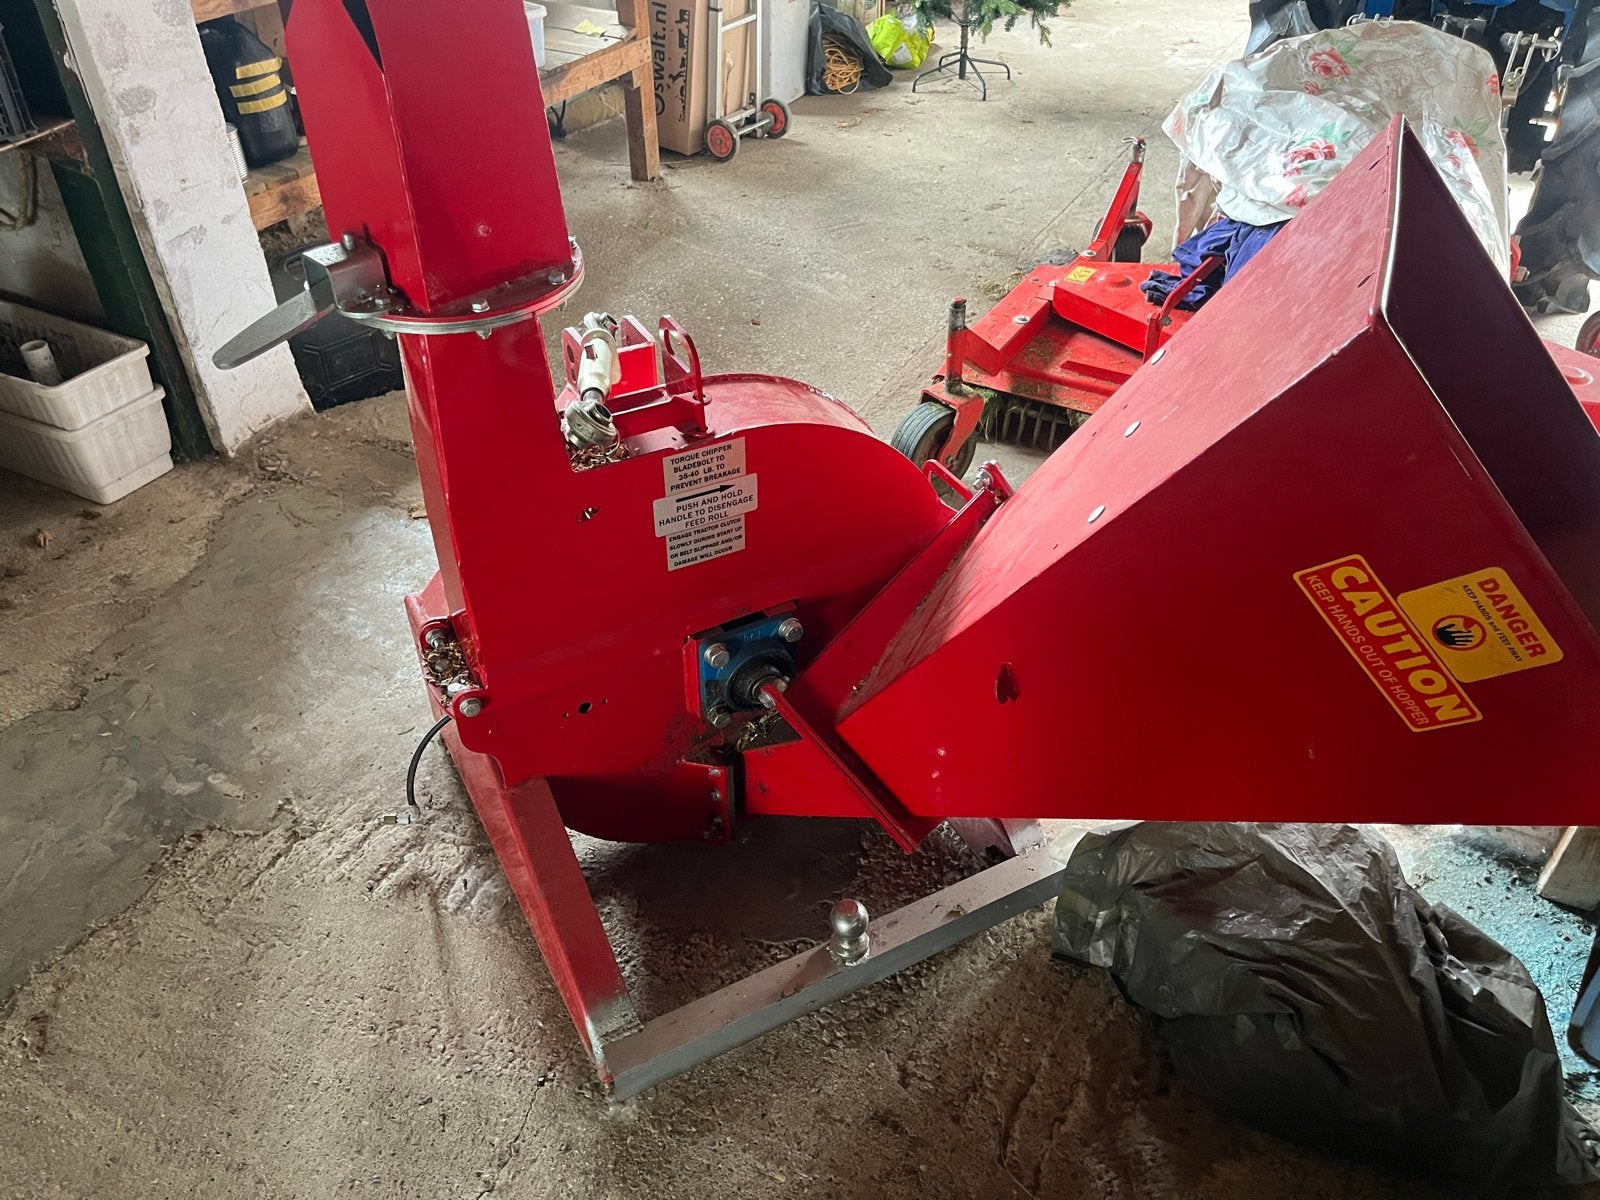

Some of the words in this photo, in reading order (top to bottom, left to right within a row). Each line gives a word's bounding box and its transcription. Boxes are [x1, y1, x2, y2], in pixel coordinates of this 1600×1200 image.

[671, 453, 699, 465] TORQUE
[702, 444, 731, 456] CHIPPER
[674, 458, 714, 473] BLADEBOLT
[671, 479, 701, 491] PREVENT
[705, 467, 741, 482] BREAKAGE
[679, 471, 699, 480] 35-40
[659, 511, 692, 526] HANDLE
[708, 495, 753, 513] DISENGAGE
[677, 502, 698, 512] PUSH
[701, 496, 718, 506] AND
[722, 489, 743, 500] HOLD
[669, 532, 692, 542] ENGAGE
[694, 525, 718, 535] TRACTOR
[721, 518, 741, 527] CLUTCH
[685, 518, 705, 528] FEED
[709, 511, 728, 522] ROLL
[670, 541, 692, 550] SLOWLY
[694, 535, 715, 544] DURING
[717, 530, 733, 538] START
[680, 548, 692, 556] BELT
[694, 541, 719, 552] SLIPPAGE
[721, 535, 742, 544] AND/OR
[674, 557, 698, 566] DAMAGE
[715, 546, 732, 554] OCCUR
[1462, 584, 1477, 600] KEEP
[1474, 599, 1492, 620] HANDS
[1489, 622, 1500, 632] and
[1497, 629, 1511, 645] FEET
[1508, 646, 1523, 662] AWAY
[1476, 577, 1546, 658] DANGER
[1306, 575, 1334, 603] KEEP
[1328, 604, 1365, 645] HANDS
[1360, 645, 1385, 668] OUT
[1378, 669, 1398, 685] OF
[1390, 685, 1429, 725] HOPPER
[1331, 566, 1472, 721] CAUTION
